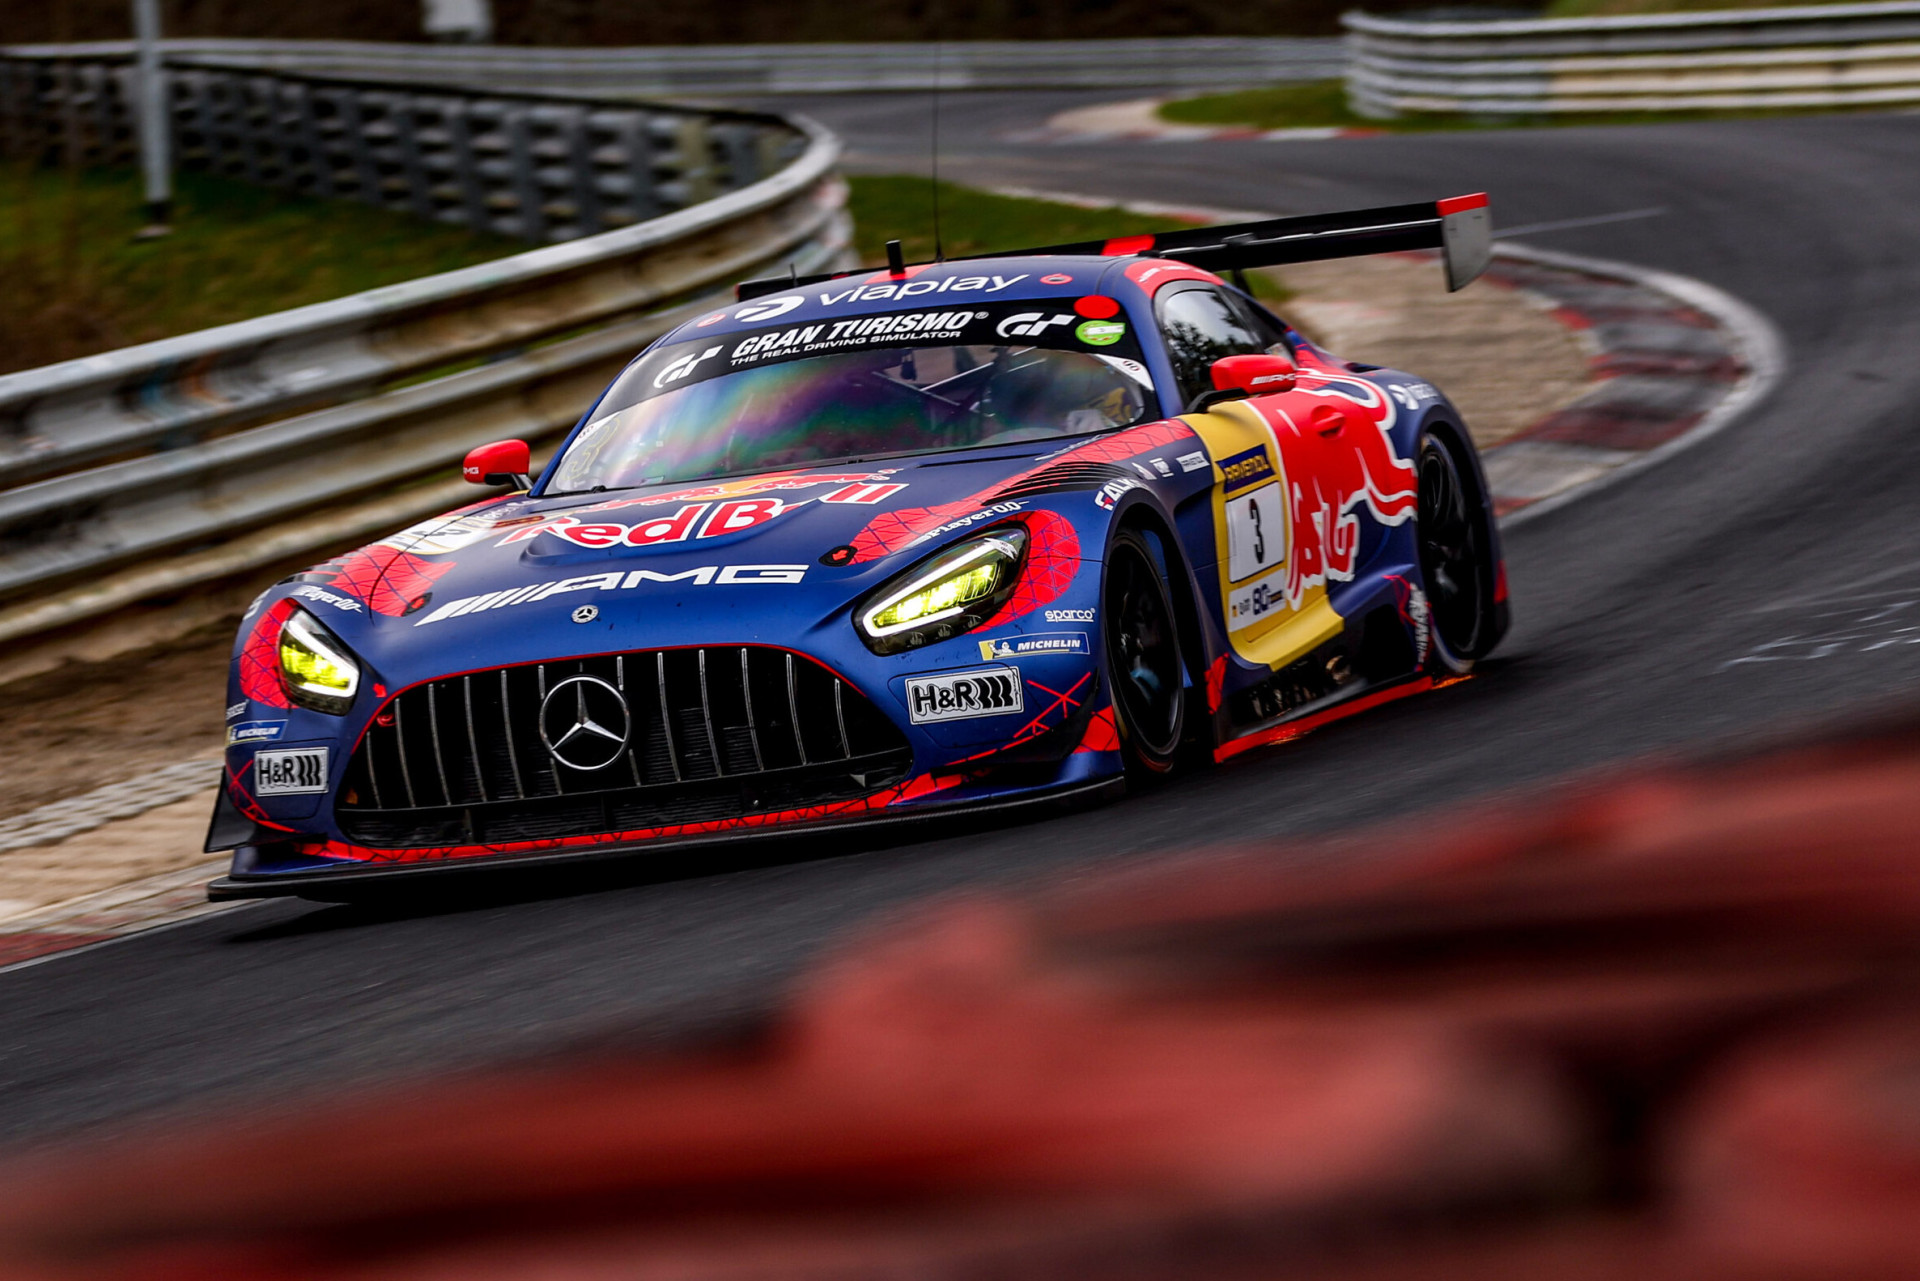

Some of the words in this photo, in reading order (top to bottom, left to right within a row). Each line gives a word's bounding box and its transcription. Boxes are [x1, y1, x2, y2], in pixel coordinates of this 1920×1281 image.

[819, 273, 1030, 307] viaplay
[730, 353, 757, 367] THE
[757, 346, 801, 363] REAL
[804, 336, 867, 356] DRIVING
[870, 330, 962, 345] SIMULATOR
[731, 329, 818, 359] GRAN
[493, 501, 714, 549] Red
[1248, 497, 1265, 565] 3
[527, 564, 811, 603] AMG
[1044, 608, 1094, 623] sparco
[1017, 639, 1081, 651] MICHELIN
[912, 679, 981, 716] H&R
[257, 756, 298, 788] H&R
